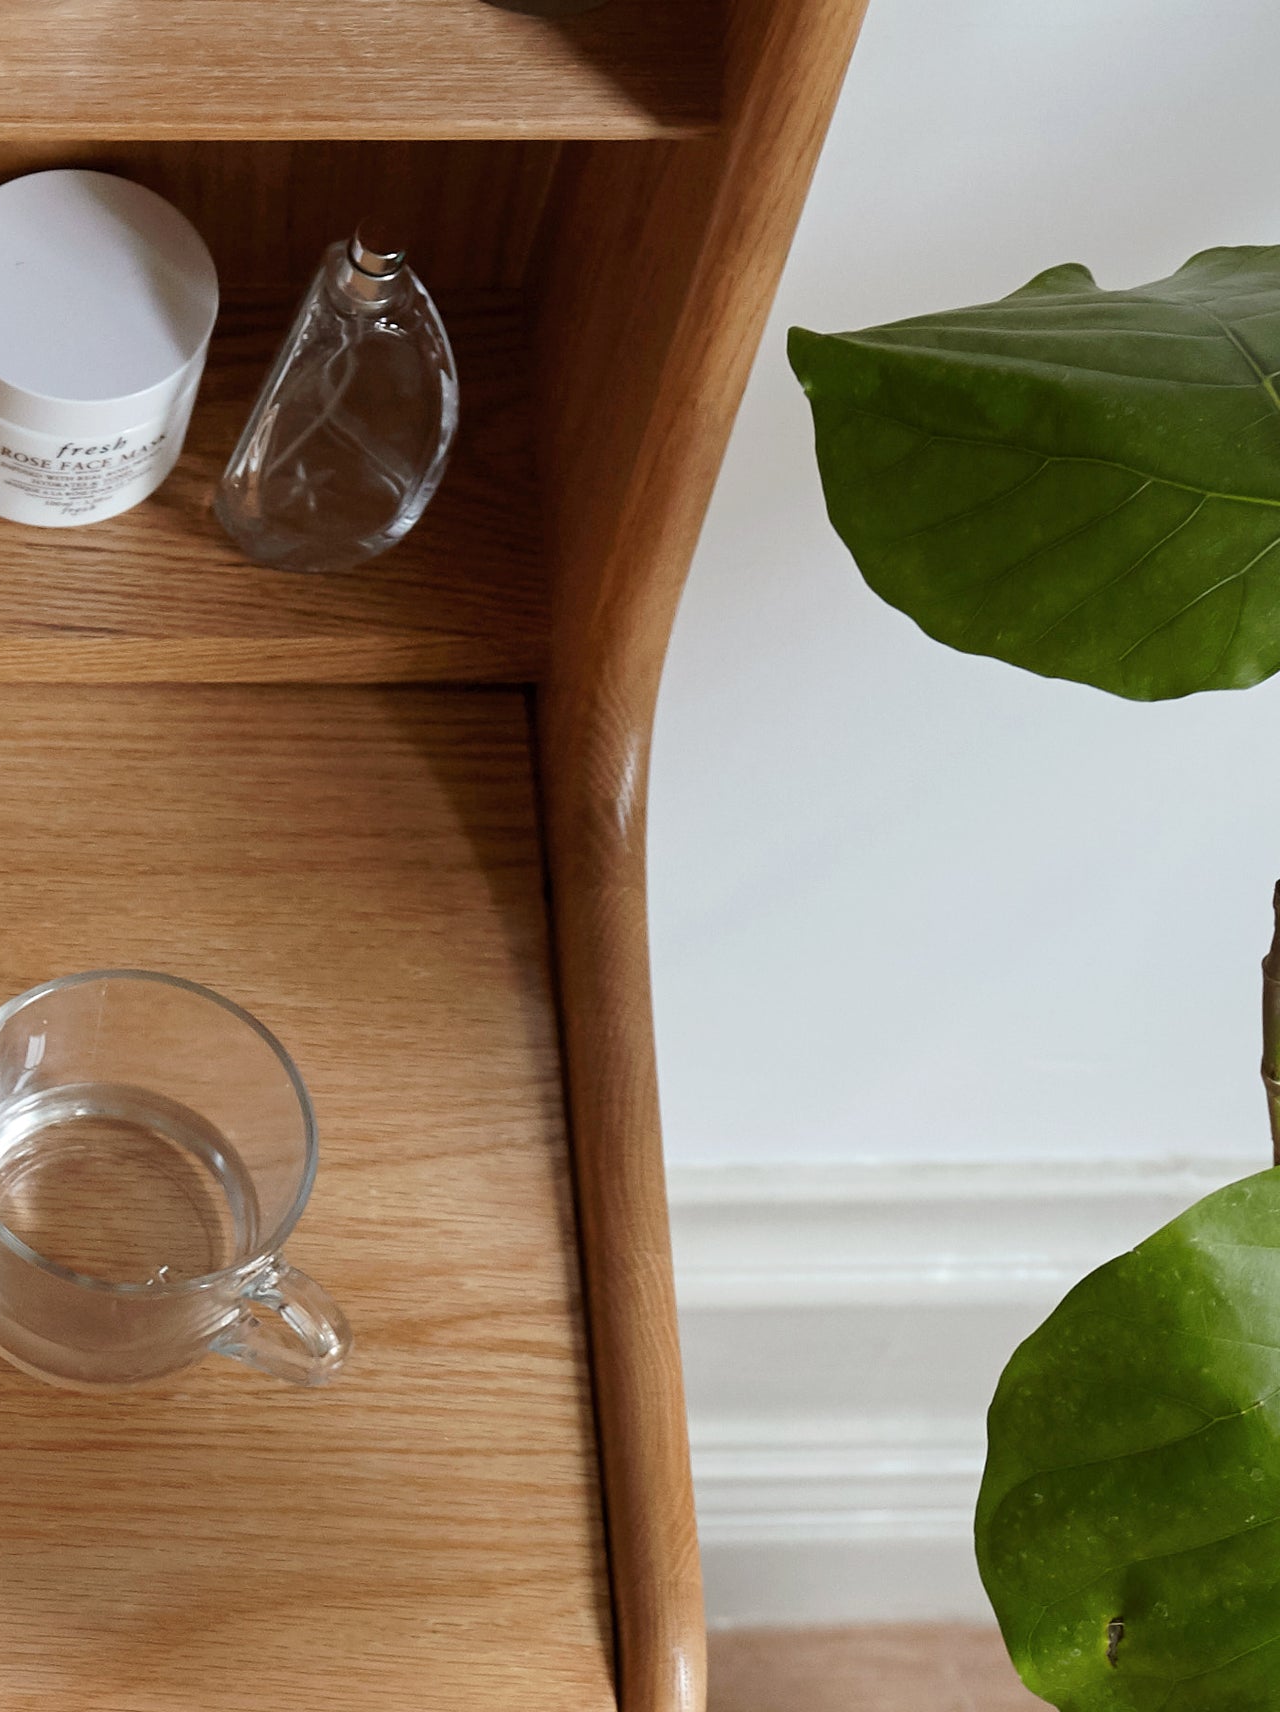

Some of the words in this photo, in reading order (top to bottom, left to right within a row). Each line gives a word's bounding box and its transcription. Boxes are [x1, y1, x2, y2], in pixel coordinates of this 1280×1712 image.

[0, 446, 53, 469] ROSE
[60, 457, 113, 471] FACE
[55, 436, 128, 459] fresh
